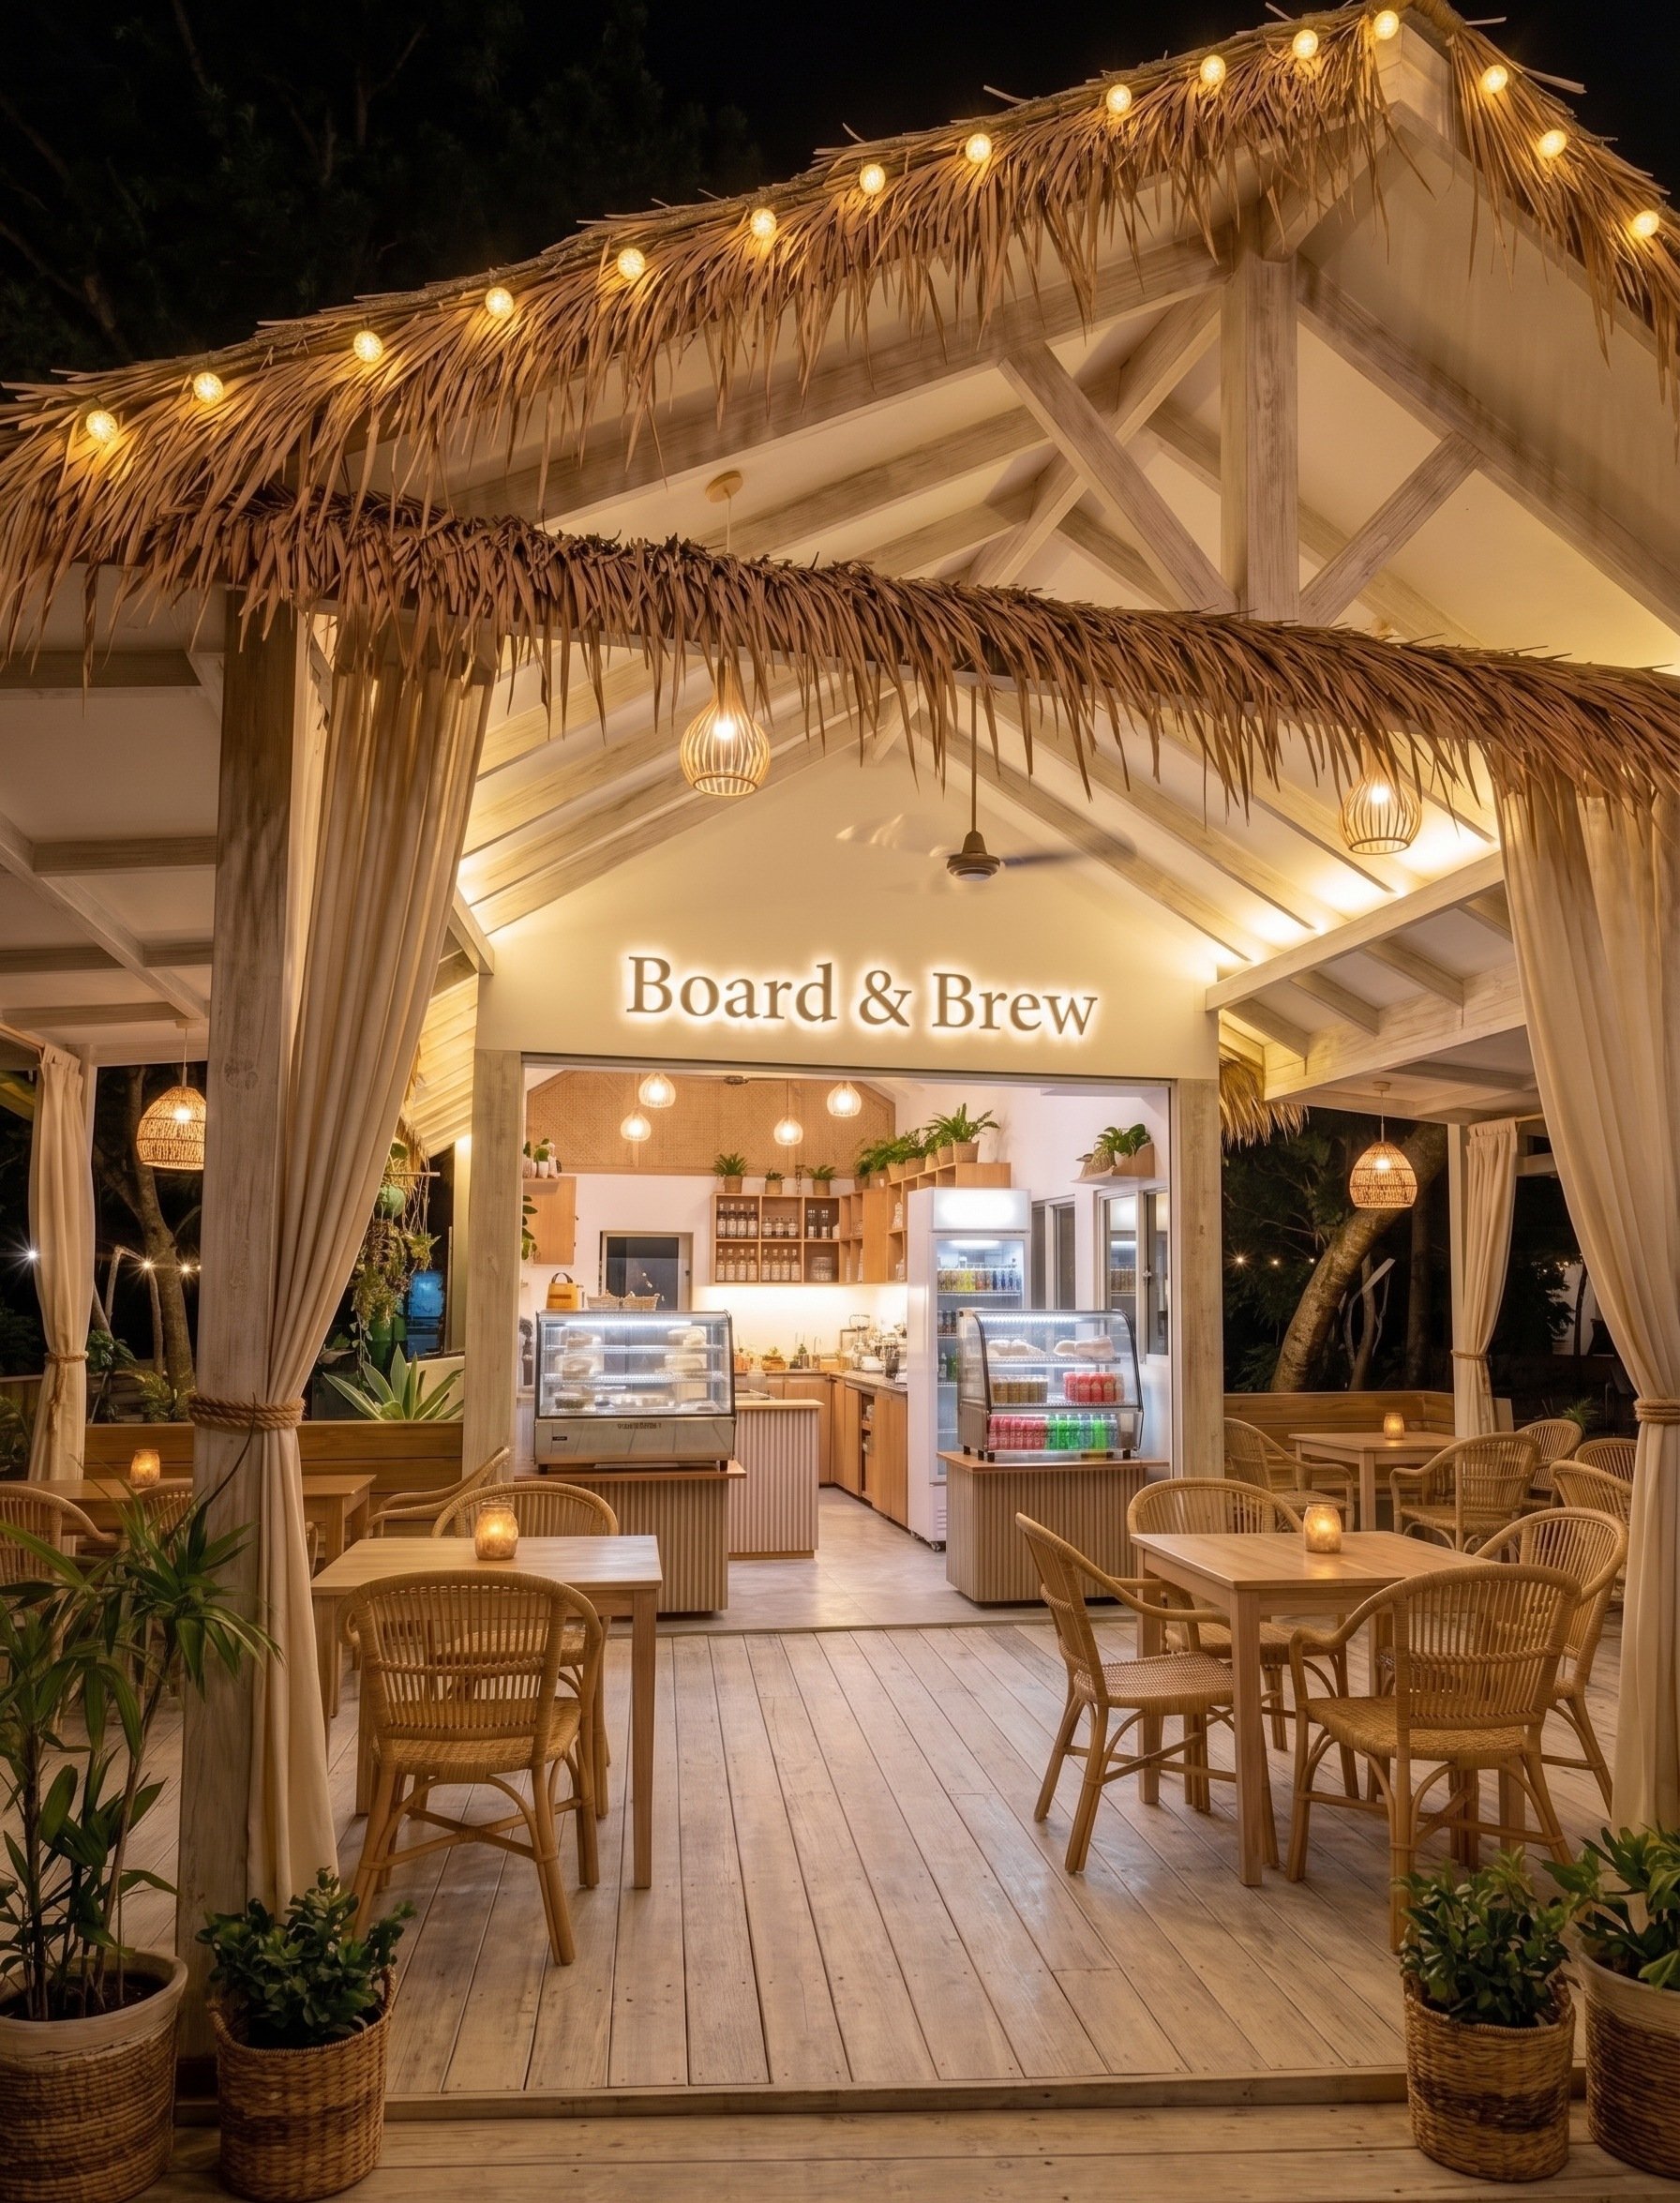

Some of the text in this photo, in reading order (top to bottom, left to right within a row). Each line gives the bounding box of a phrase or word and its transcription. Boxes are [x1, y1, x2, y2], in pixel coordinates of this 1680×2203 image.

[626, 956, 1098, 1036] Board & Brew
